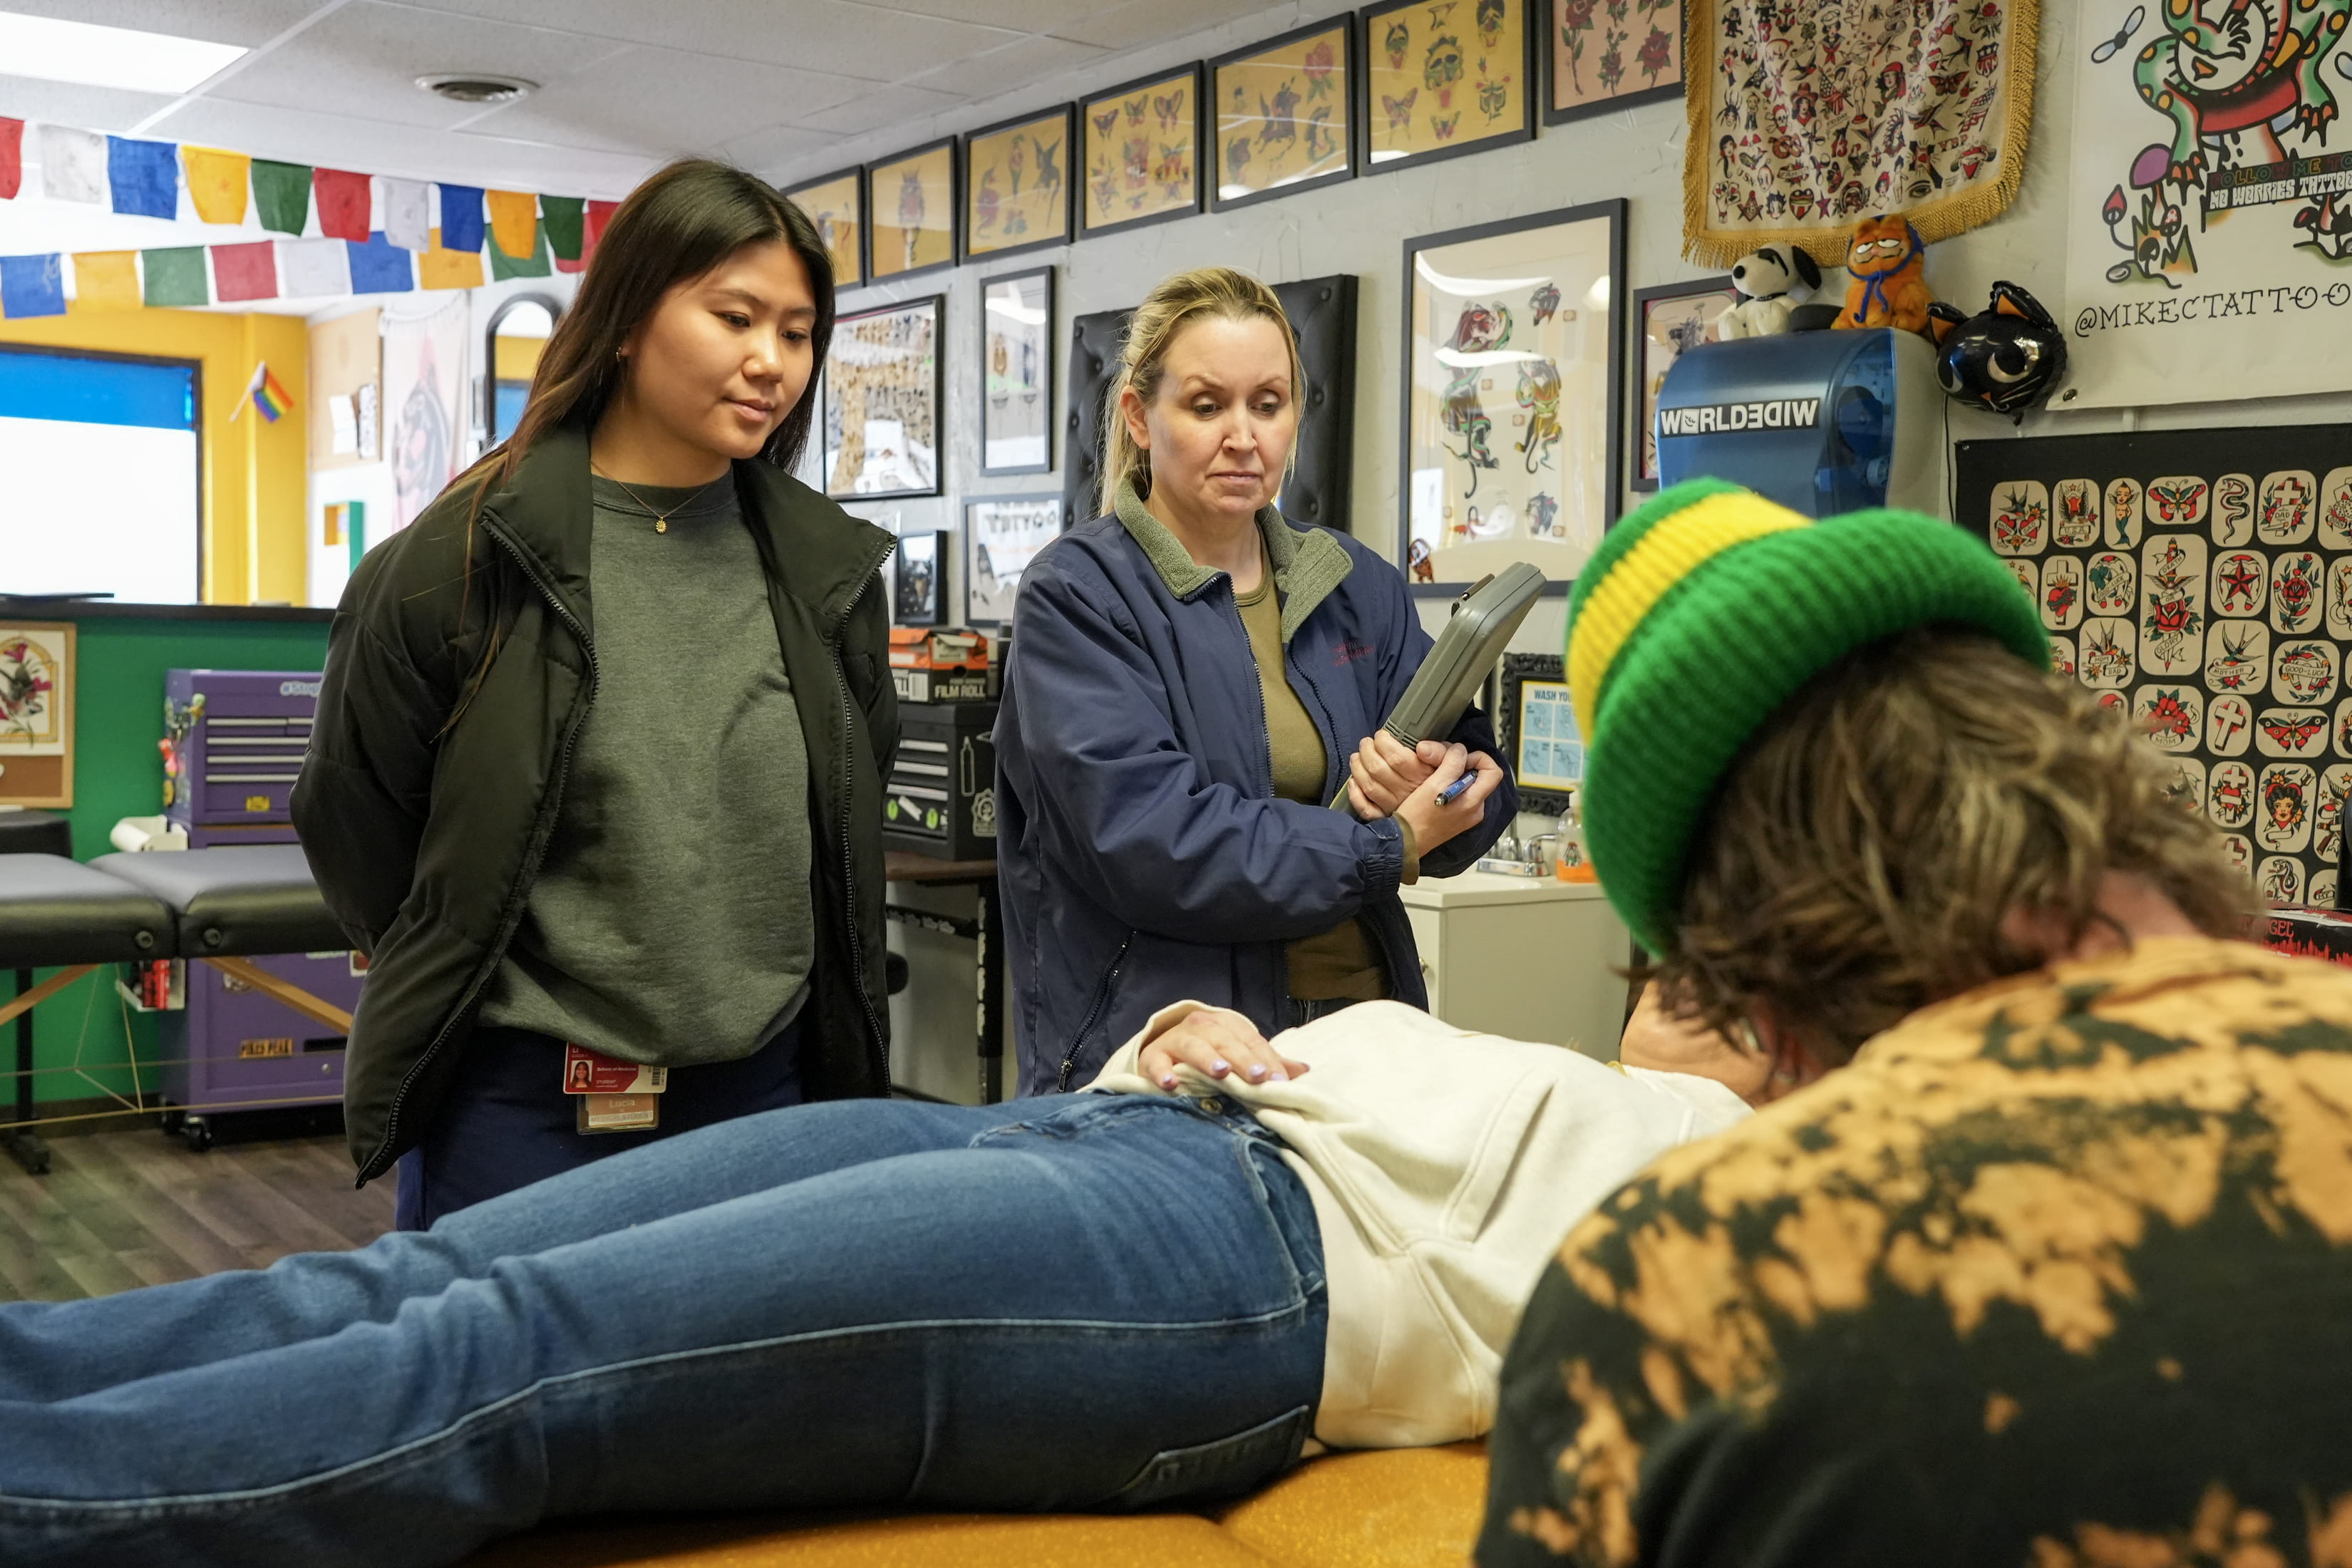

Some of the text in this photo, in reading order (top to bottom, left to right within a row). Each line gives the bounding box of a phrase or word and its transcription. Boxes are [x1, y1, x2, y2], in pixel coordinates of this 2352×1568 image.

[1832, 140, 1848, 158] 13
[2293, 158, 2321, 177] ME
[2210, 189, 2228, 210] NO
[2232, 179, 2295, 206] WORRIES
[1998, 522, 2012, 533] MOM
[2162, 556, 2182, 574] DEATH
[2157, 636, 2180, 655] GLORY
[2213, 667, 2244, 676] MOTHER
[1534, 689, 1557, 701] WASH
[2155, 737, 2176, 746] MOM
